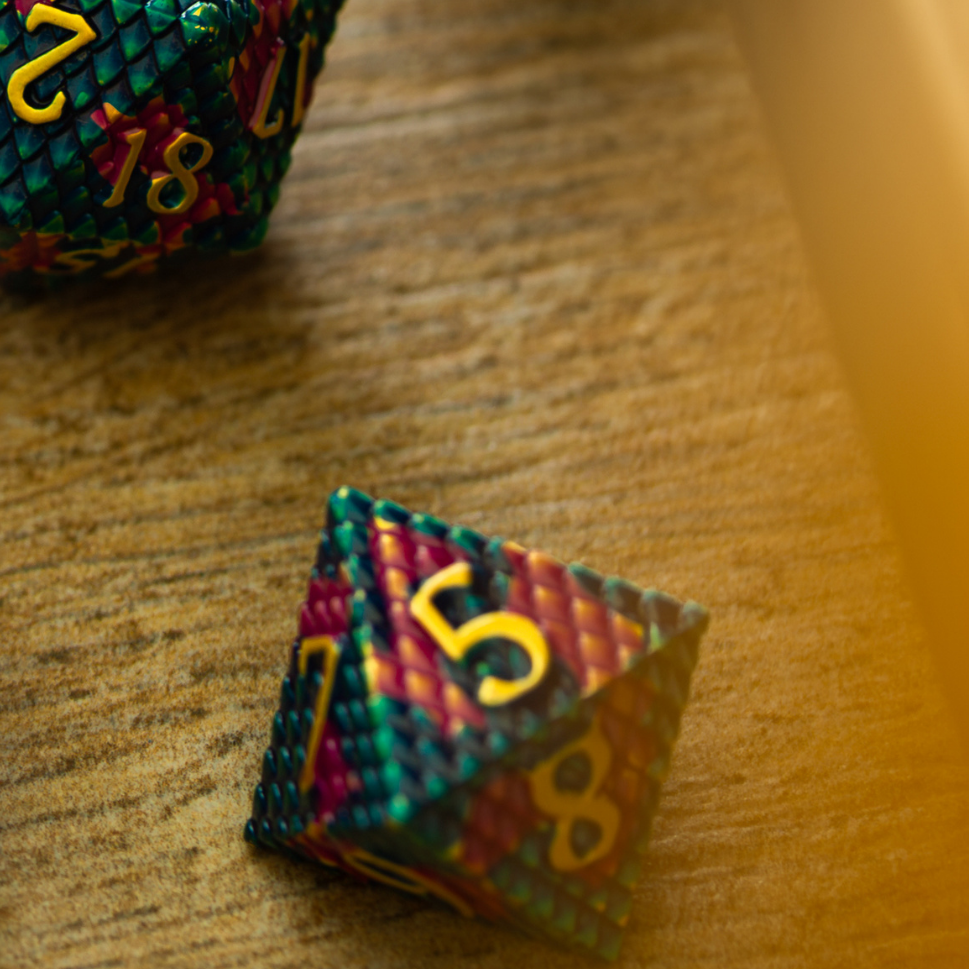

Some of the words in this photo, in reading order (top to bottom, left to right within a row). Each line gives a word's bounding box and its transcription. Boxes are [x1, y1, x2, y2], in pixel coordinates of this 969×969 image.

[8, 2, 97, 124] 2
[102, 128, 213, 214] 18
[410, 562, 549, 706] 5
[299, 635, 338, 791] 7
[532, 727, 619, 871] 8
